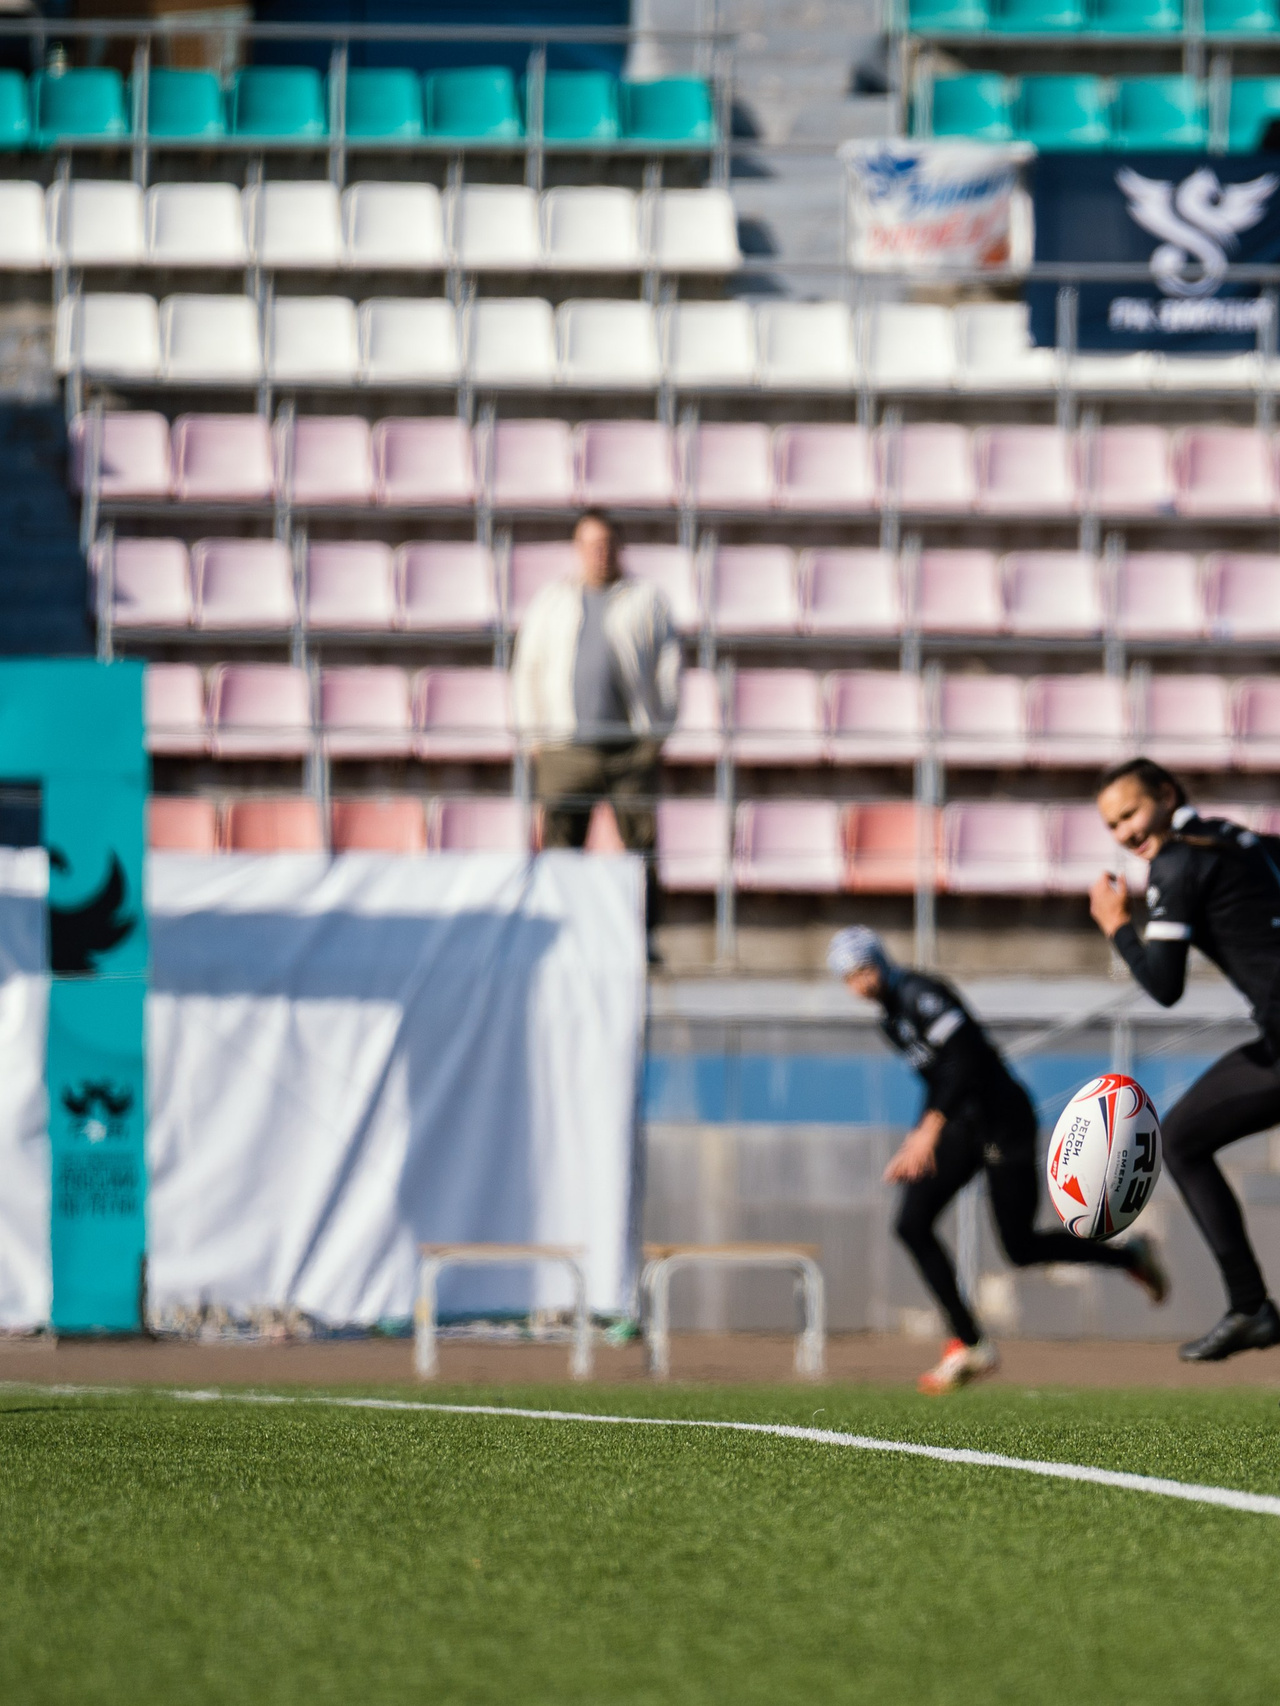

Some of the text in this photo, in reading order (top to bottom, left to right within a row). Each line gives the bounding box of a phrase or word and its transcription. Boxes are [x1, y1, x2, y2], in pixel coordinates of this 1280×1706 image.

[1062, 1116, 1082, 1165] РОССИИ
[1072, 1119, 1091, 1156] РЕГБИ
[1114, 1149, 1128, 1192] СМЕРЧ
